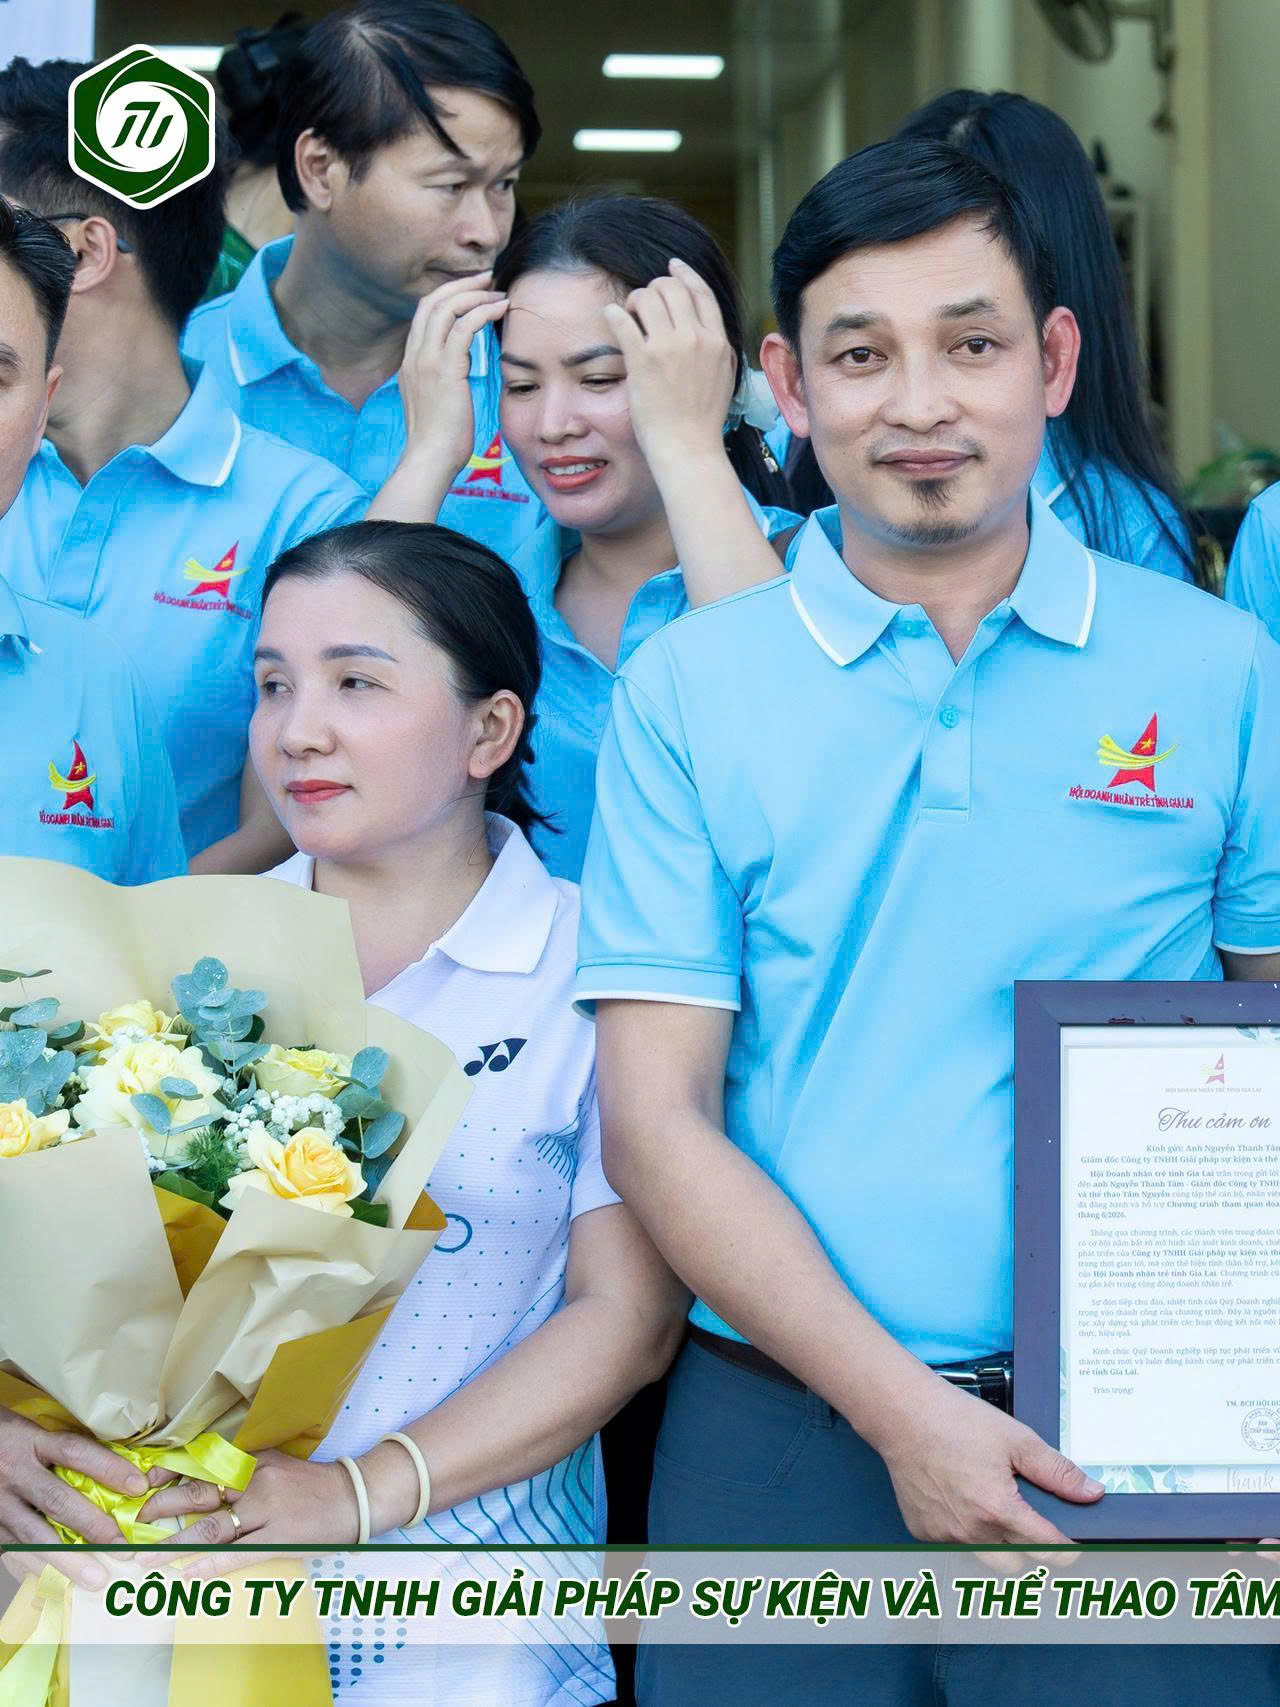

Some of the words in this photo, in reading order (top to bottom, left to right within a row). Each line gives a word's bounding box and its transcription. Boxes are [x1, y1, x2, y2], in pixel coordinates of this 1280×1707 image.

[1069, 784, 1083, 800] HỘI
[1085, 789, 1112, 803] DOANH
[1114, 792, 1134, 805] NHÂN
[1206, 1112, 1246, 1129] cảm
[1250, 1115, 1272, 1129] ơn
[1080, 1155, 1102, 1163] Giám
[1104, 1154, 1118, 1163] đốc
[1120, 1155, 1140, 1166] Công
[1143, 1155, 1150, 1166] ty
[1179, 1155, 1196, 1163] Giải
[1198, 1155, 1218, 1165] pháp
[1220, 1157, 1230, 1165] sự
[1233, 1154, 1250, 1165] kiện
[1253, 1154, 1262, 1162] và
[1264, 1154, 1277, 1162] thể
[1090, 1169, 1103, 1179] Hội
[1133, 1169, 1152, 1177] nhân
[1168, 1168, 1184, 1177] tỉnh
[1110, 1178, 1138, 1190] Nguyễn
[1168, 1179, 1183, 1187] Tâm
[1190, 1179, 1210, 1187] Giám
[1213, 1178, 1225, 1187] đốc
[1228, 1179, 1247, 1189] Công
[1078, 1210, 1099, 1221] tháng
